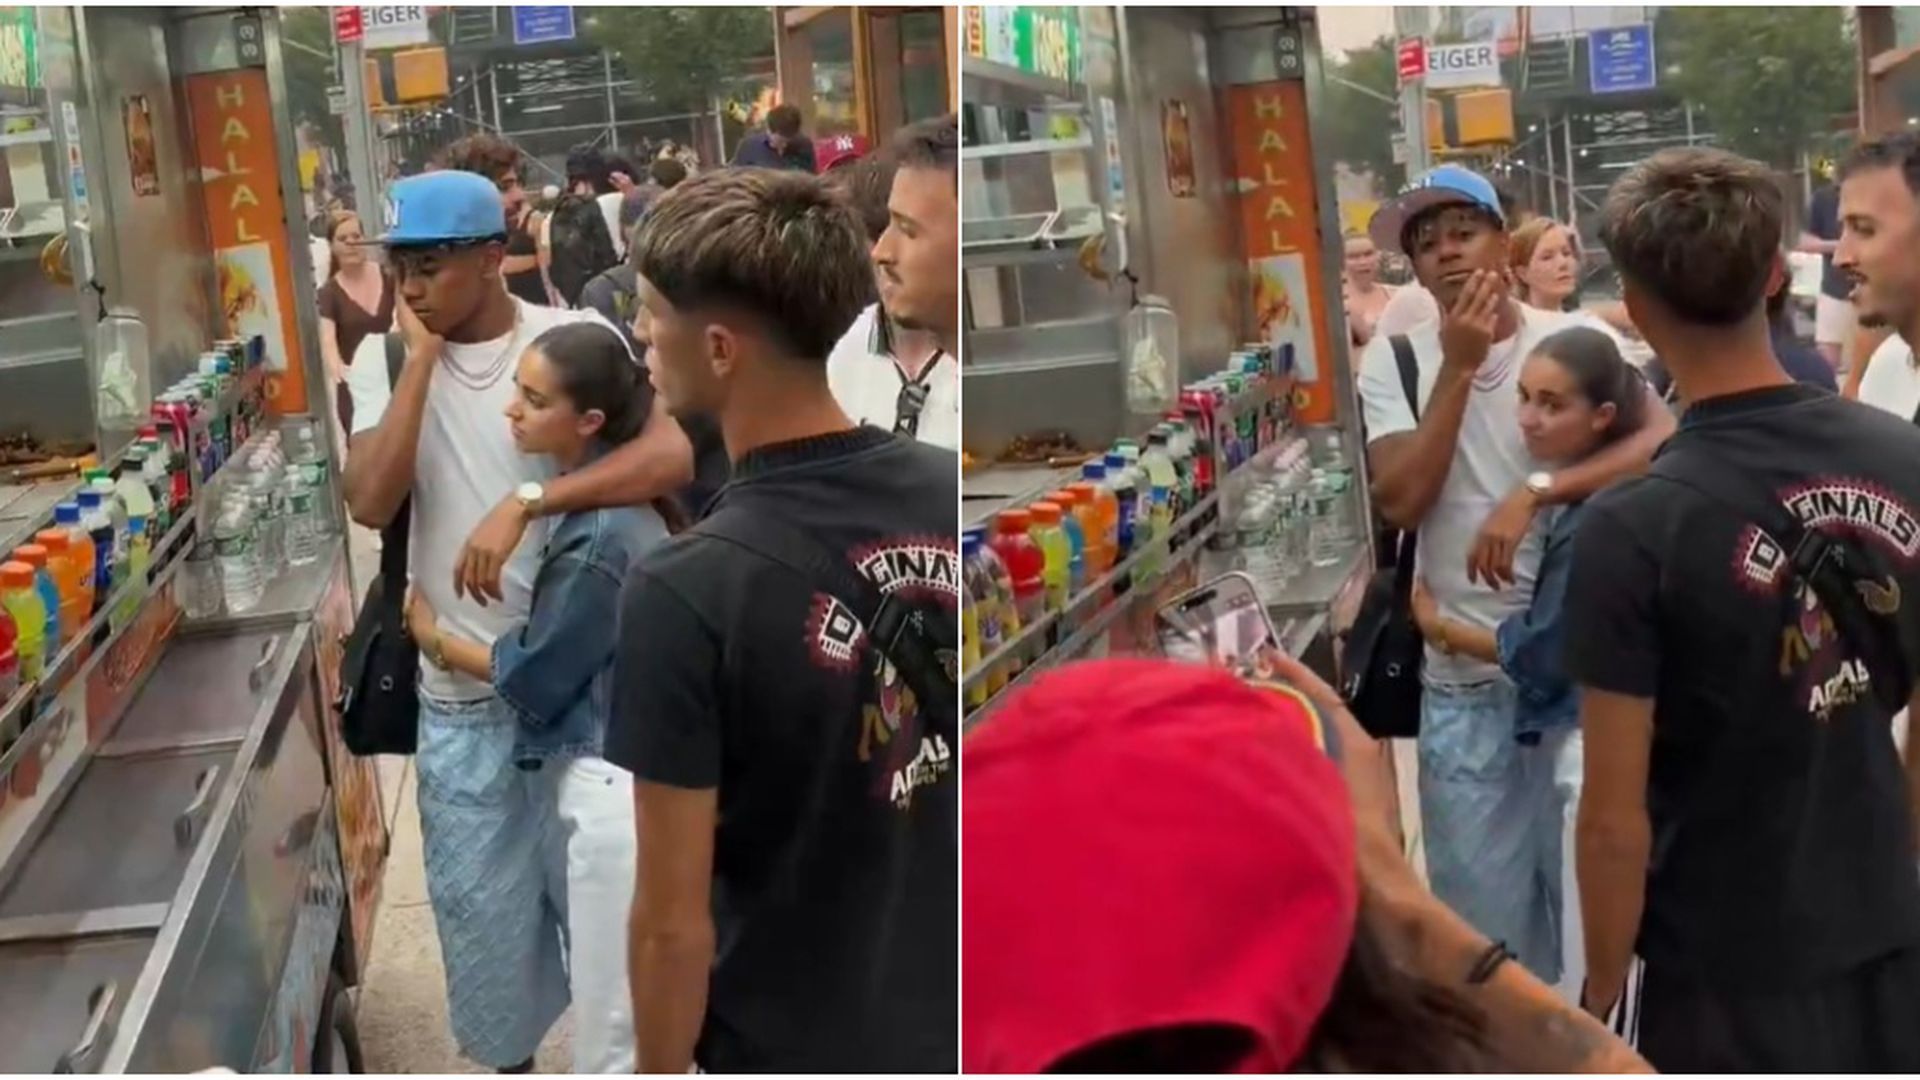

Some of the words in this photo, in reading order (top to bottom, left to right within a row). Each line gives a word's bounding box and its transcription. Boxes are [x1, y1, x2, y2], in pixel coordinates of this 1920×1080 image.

[1428, 47, 1492, 70] EIGER
[216, 84, 262, 242] HALAL
[1255, 94, 1298, 251] HALAL
